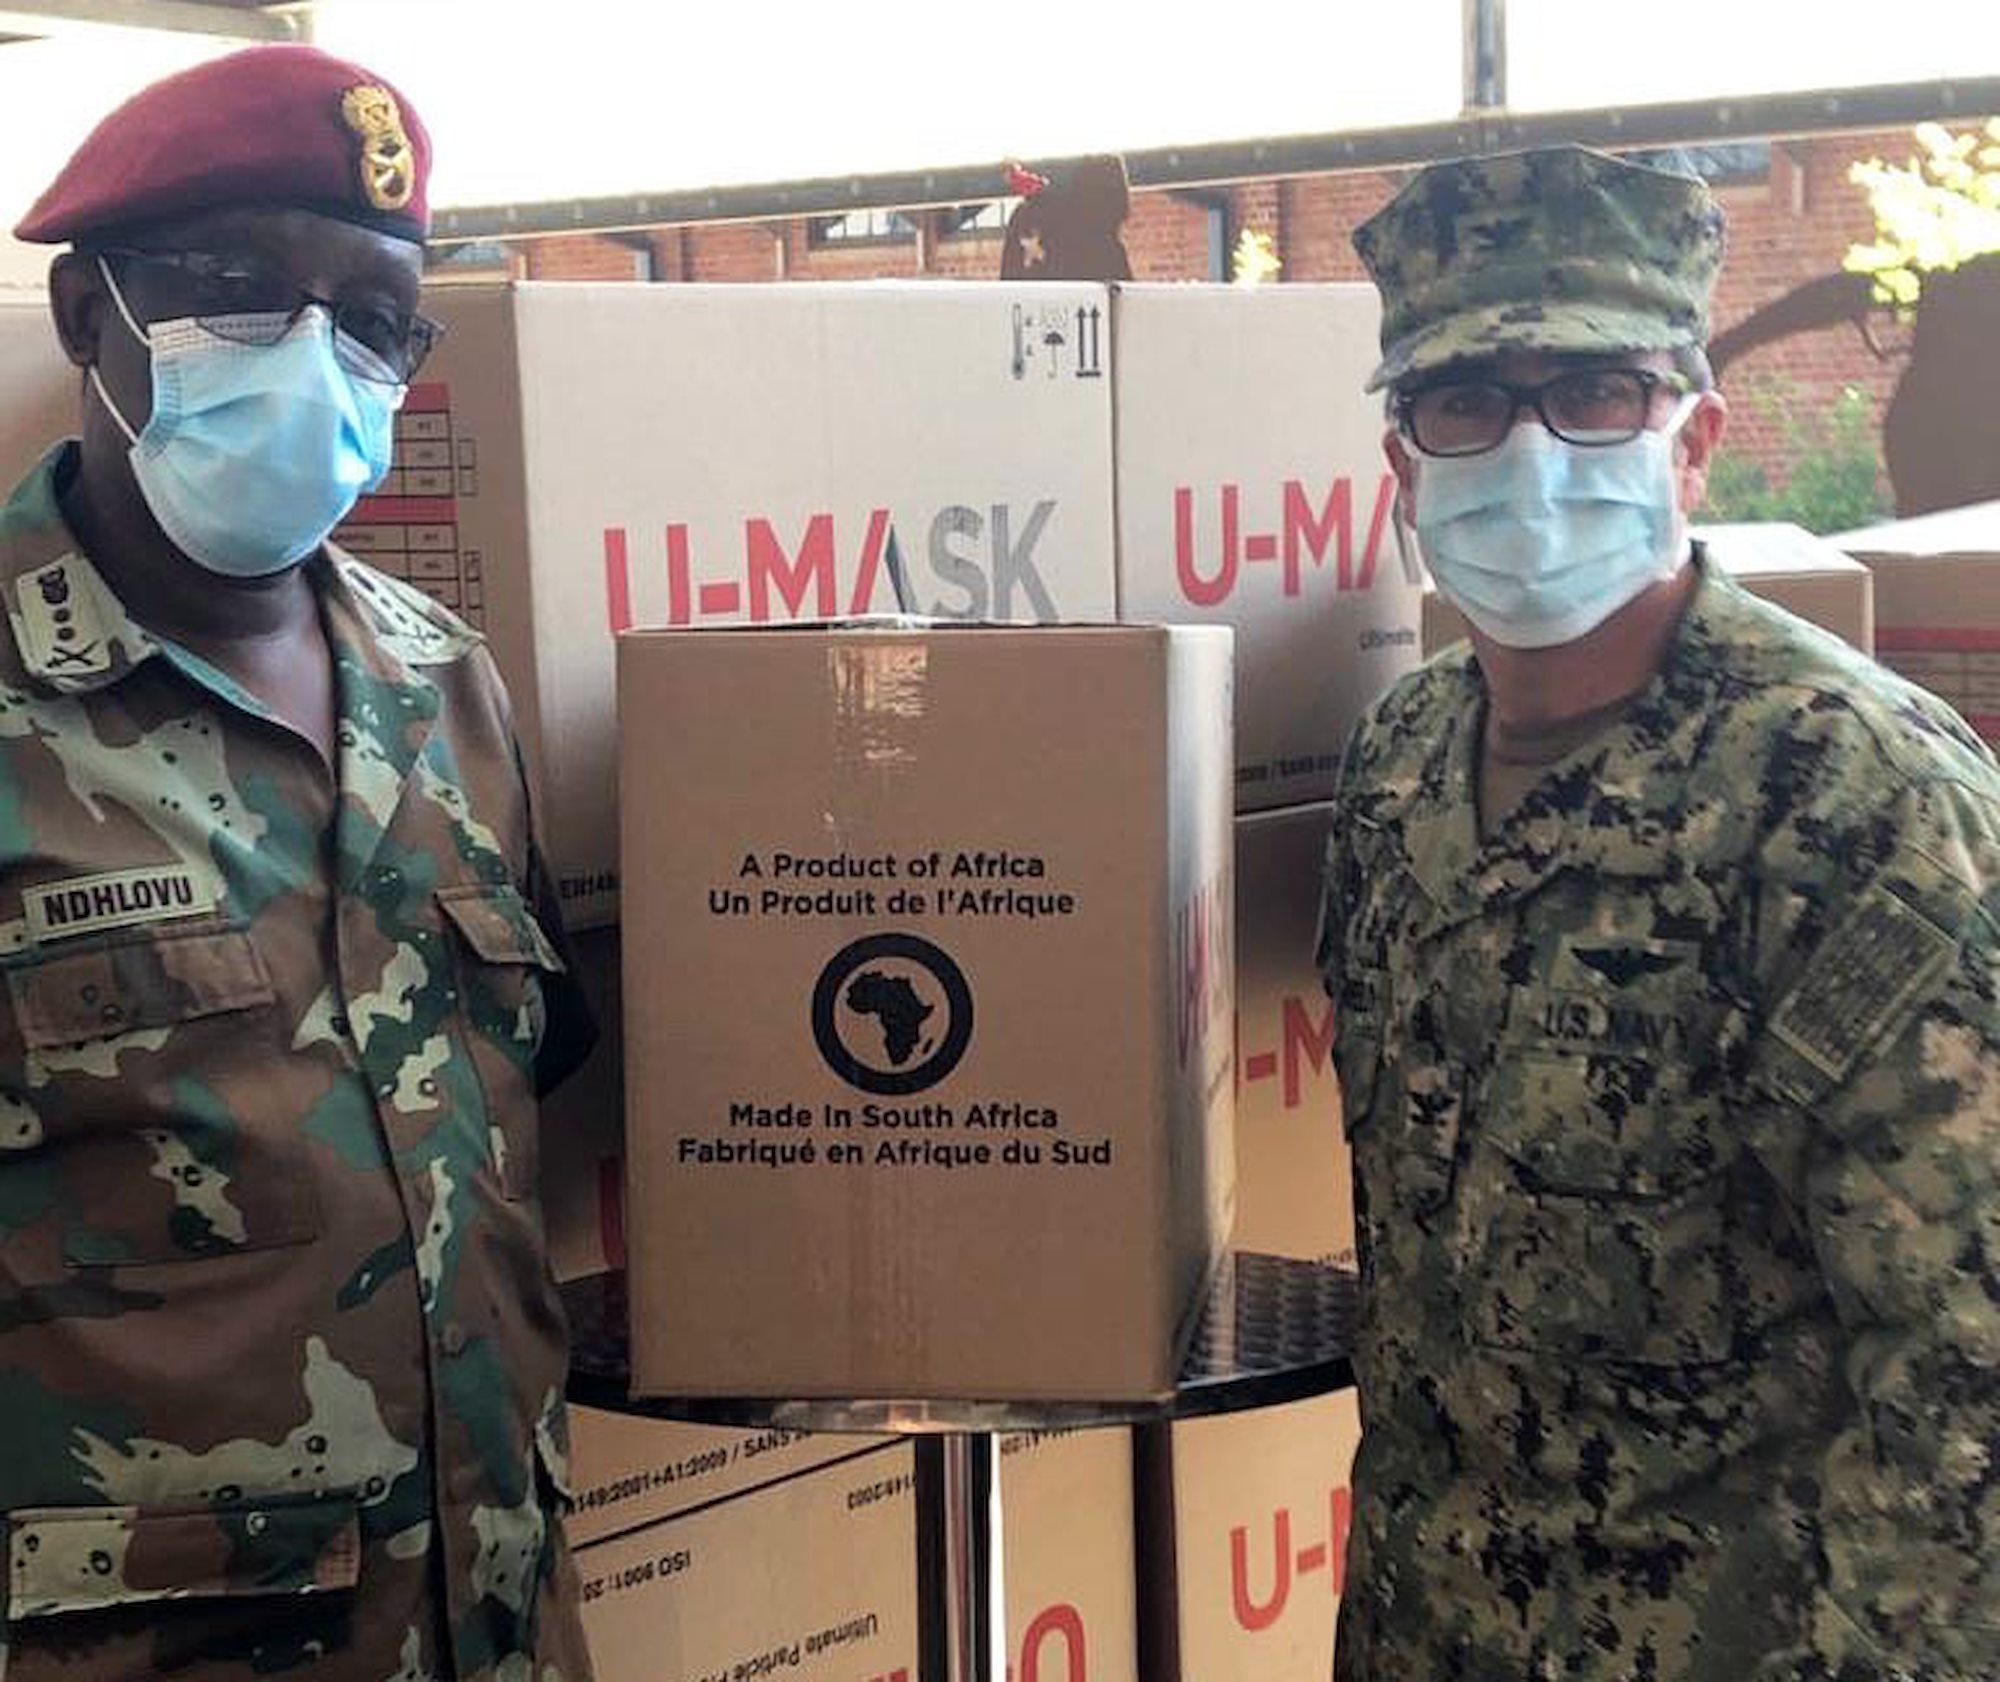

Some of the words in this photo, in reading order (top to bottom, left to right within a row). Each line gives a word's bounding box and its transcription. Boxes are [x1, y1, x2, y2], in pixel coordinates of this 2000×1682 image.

[739, 854, 762, 878] A
[773, 854, 897, 879] Product
[908, 853, 940, 878] of
[951, 853, 1046, 878] Africa
[42, 874, 194, 927] NDHLOVU
[708, 891, 750, 915] Un
[761, 890, 876, 916] Produit
[887, 890, 927, 915] de
[937, 889, 1075, 920] l'Afrique
[729, 1104, 813, 1129] Made
[824, 1105, 852, 1129] In
[862, 1104, 954, 1129] South
[965, 1104, 1058, 1129] Africa
[677, 1137, 816, 1167] Fabriqué
[826, 1145, 864, 1164] en
[875, 1139, 991, 1168] Afrique
[1002, 1139, 1041, 1165] du
[1052, 1139, 1111, 1165] Sud
[659, 1550, 692, 1576] ISO
[805, 1612, 879, 1653] Ultimate
